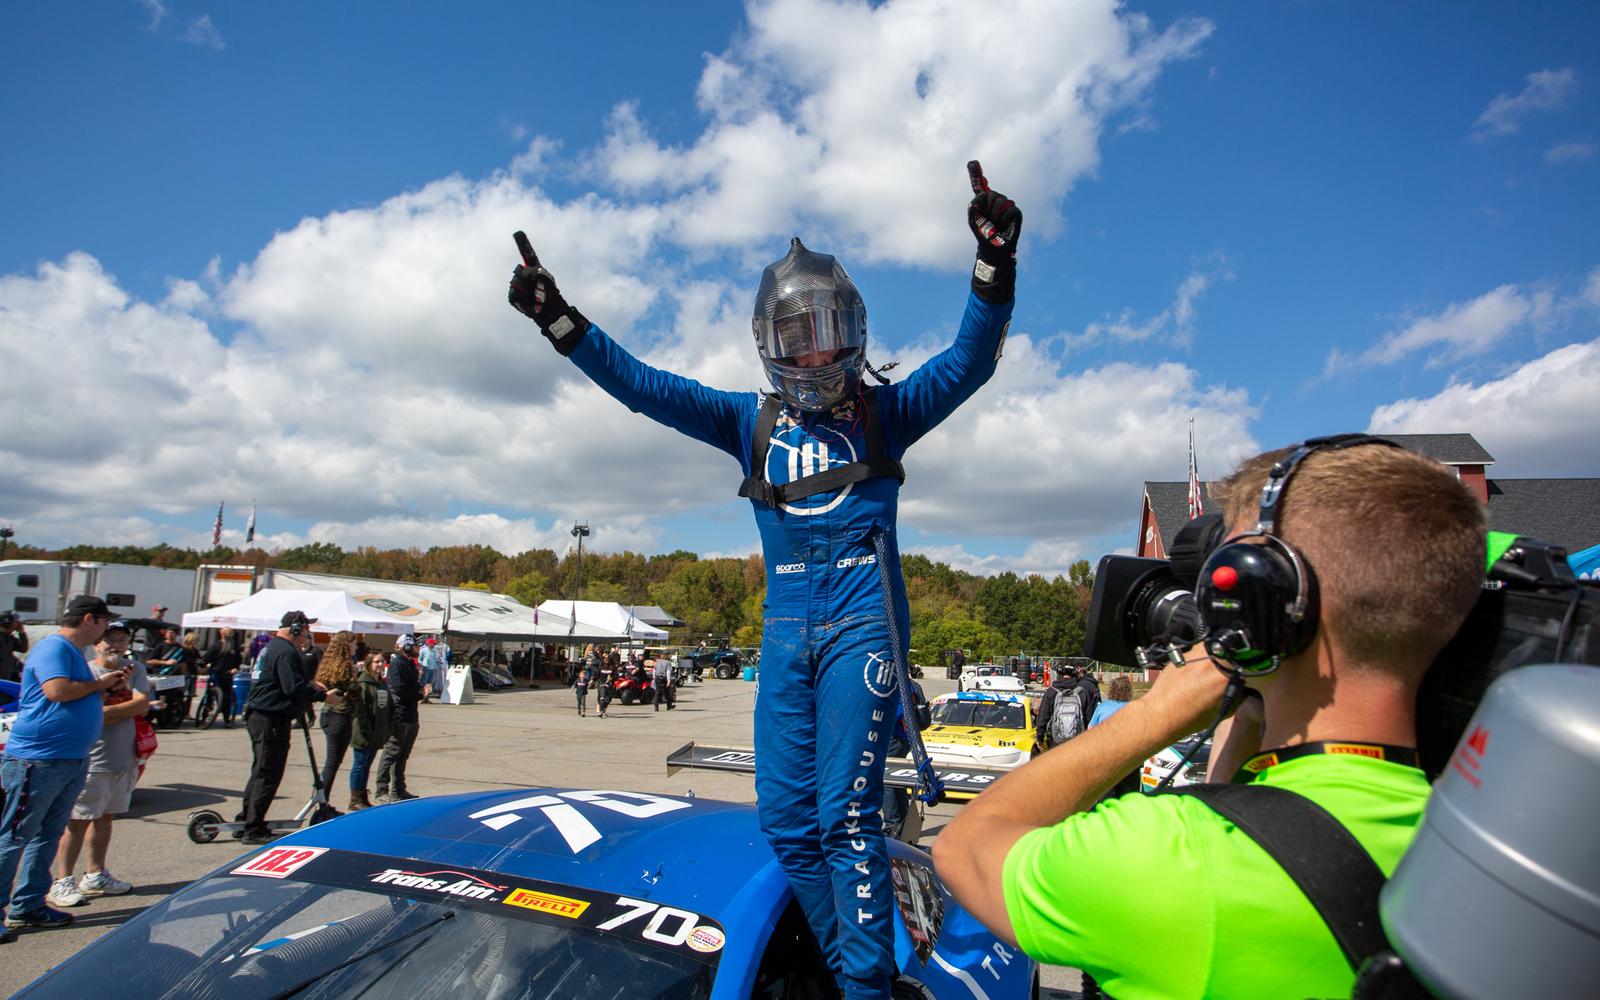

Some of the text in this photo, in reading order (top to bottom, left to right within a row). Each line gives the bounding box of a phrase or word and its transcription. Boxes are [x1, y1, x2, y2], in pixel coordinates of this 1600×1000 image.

[775, 562, 806, 574] sparco
[890, 768, 996, 784] CRS
[846, 710, 884, 924] TRACKHOUSE
[245, 849, 315, 873] TA2
[370, 868, 495, 900] Trans Am
[511, 892, 581, 914] PIRELLI
[595, 896, 700, 946] 70
[981, 941, 1016, 981] TR
